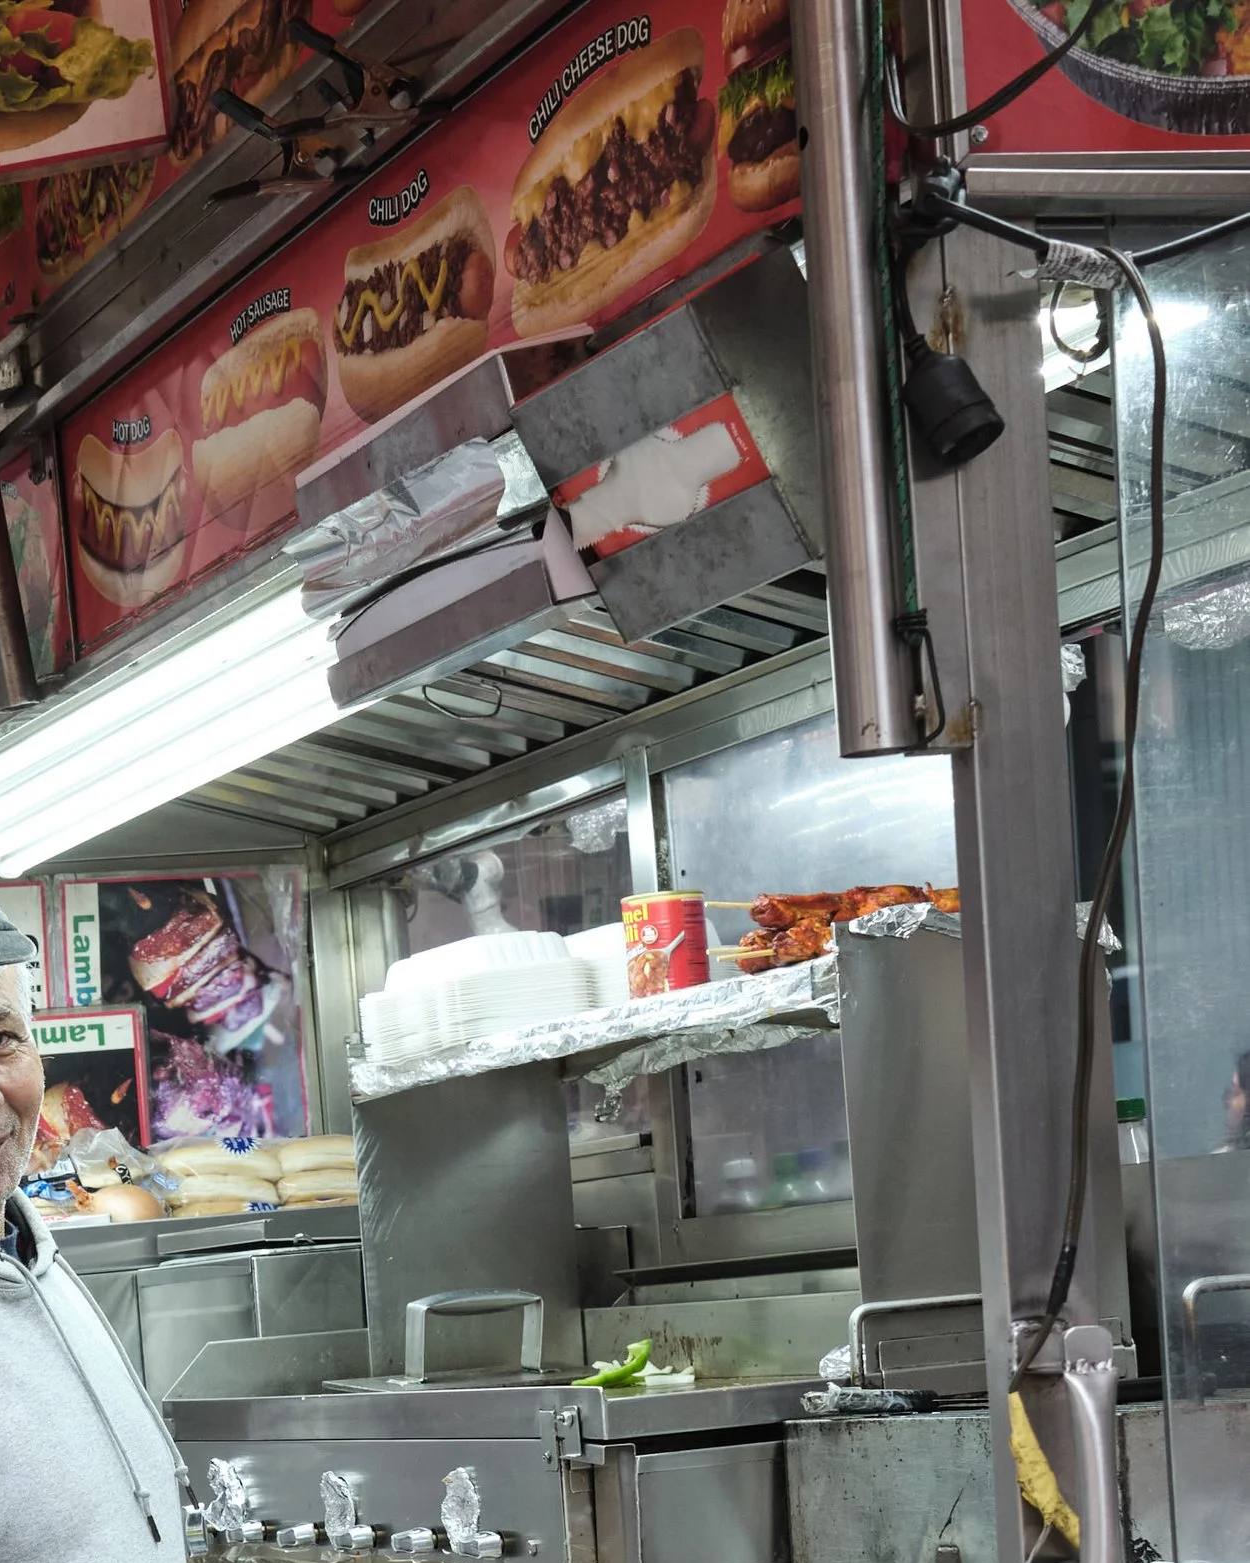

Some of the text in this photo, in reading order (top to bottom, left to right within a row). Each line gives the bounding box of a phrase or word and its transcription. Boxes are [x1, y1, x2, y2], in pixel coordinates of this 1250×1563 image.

[529, 17, 649, 139] CHILI CHEESE DOG
[369, 170, 428, 220] CHILI DOG
[230, 289, 290, 342] HOT SAUSAGE
[113, 416, 150, 441] HOT DOG
[72, 915, 97, 1006] Lamb
